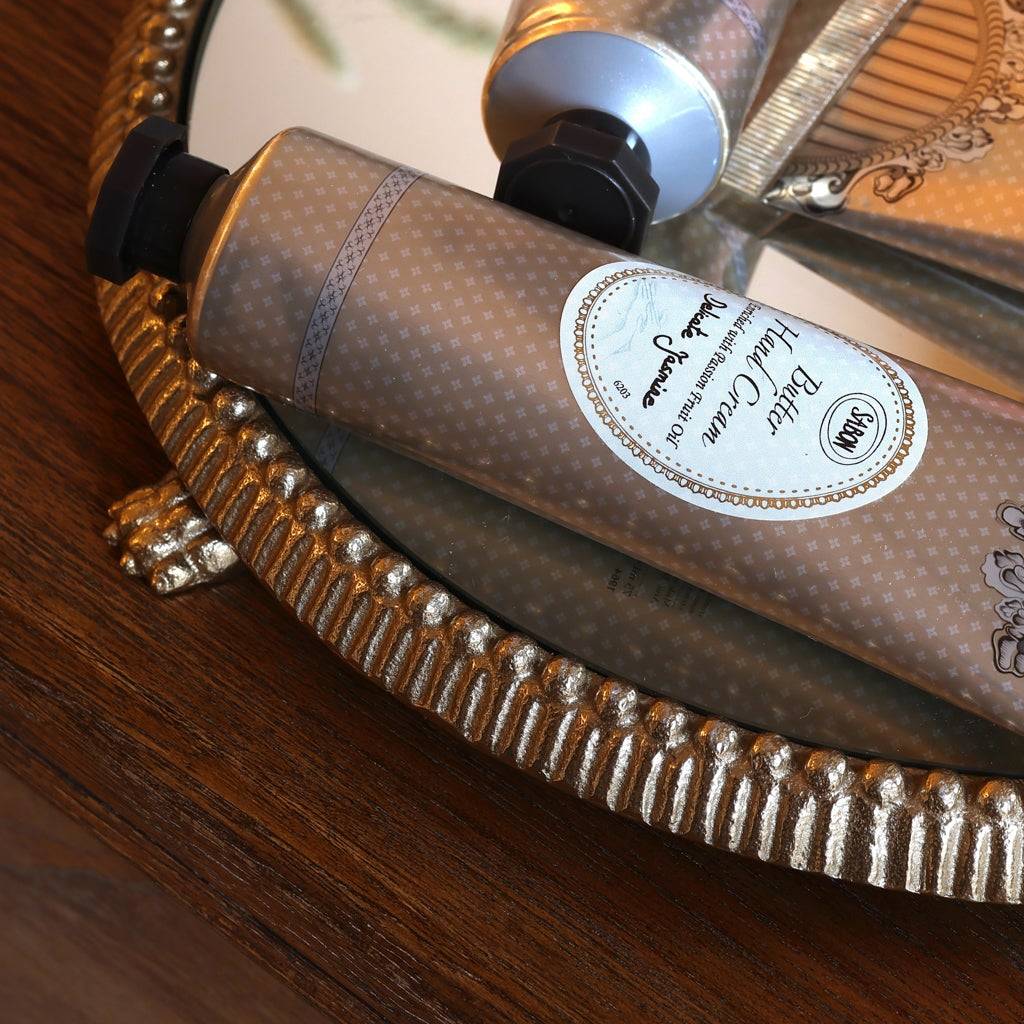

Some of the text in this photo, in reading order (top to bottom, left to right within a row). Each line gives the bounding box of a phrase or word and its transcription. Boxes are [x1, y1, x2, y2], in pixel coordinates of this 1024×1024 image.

[613, 380, 631, 400] 6203
[642, 293, 728, 409] Delicate Jasmine
[666, 302, 762, 450] Enriched with Passion Fruit Oil
[701, 318, 800, 448] Hand Cream
[766, 365, 823, 436] Butter
[832, 406, 875, 454] SABON
